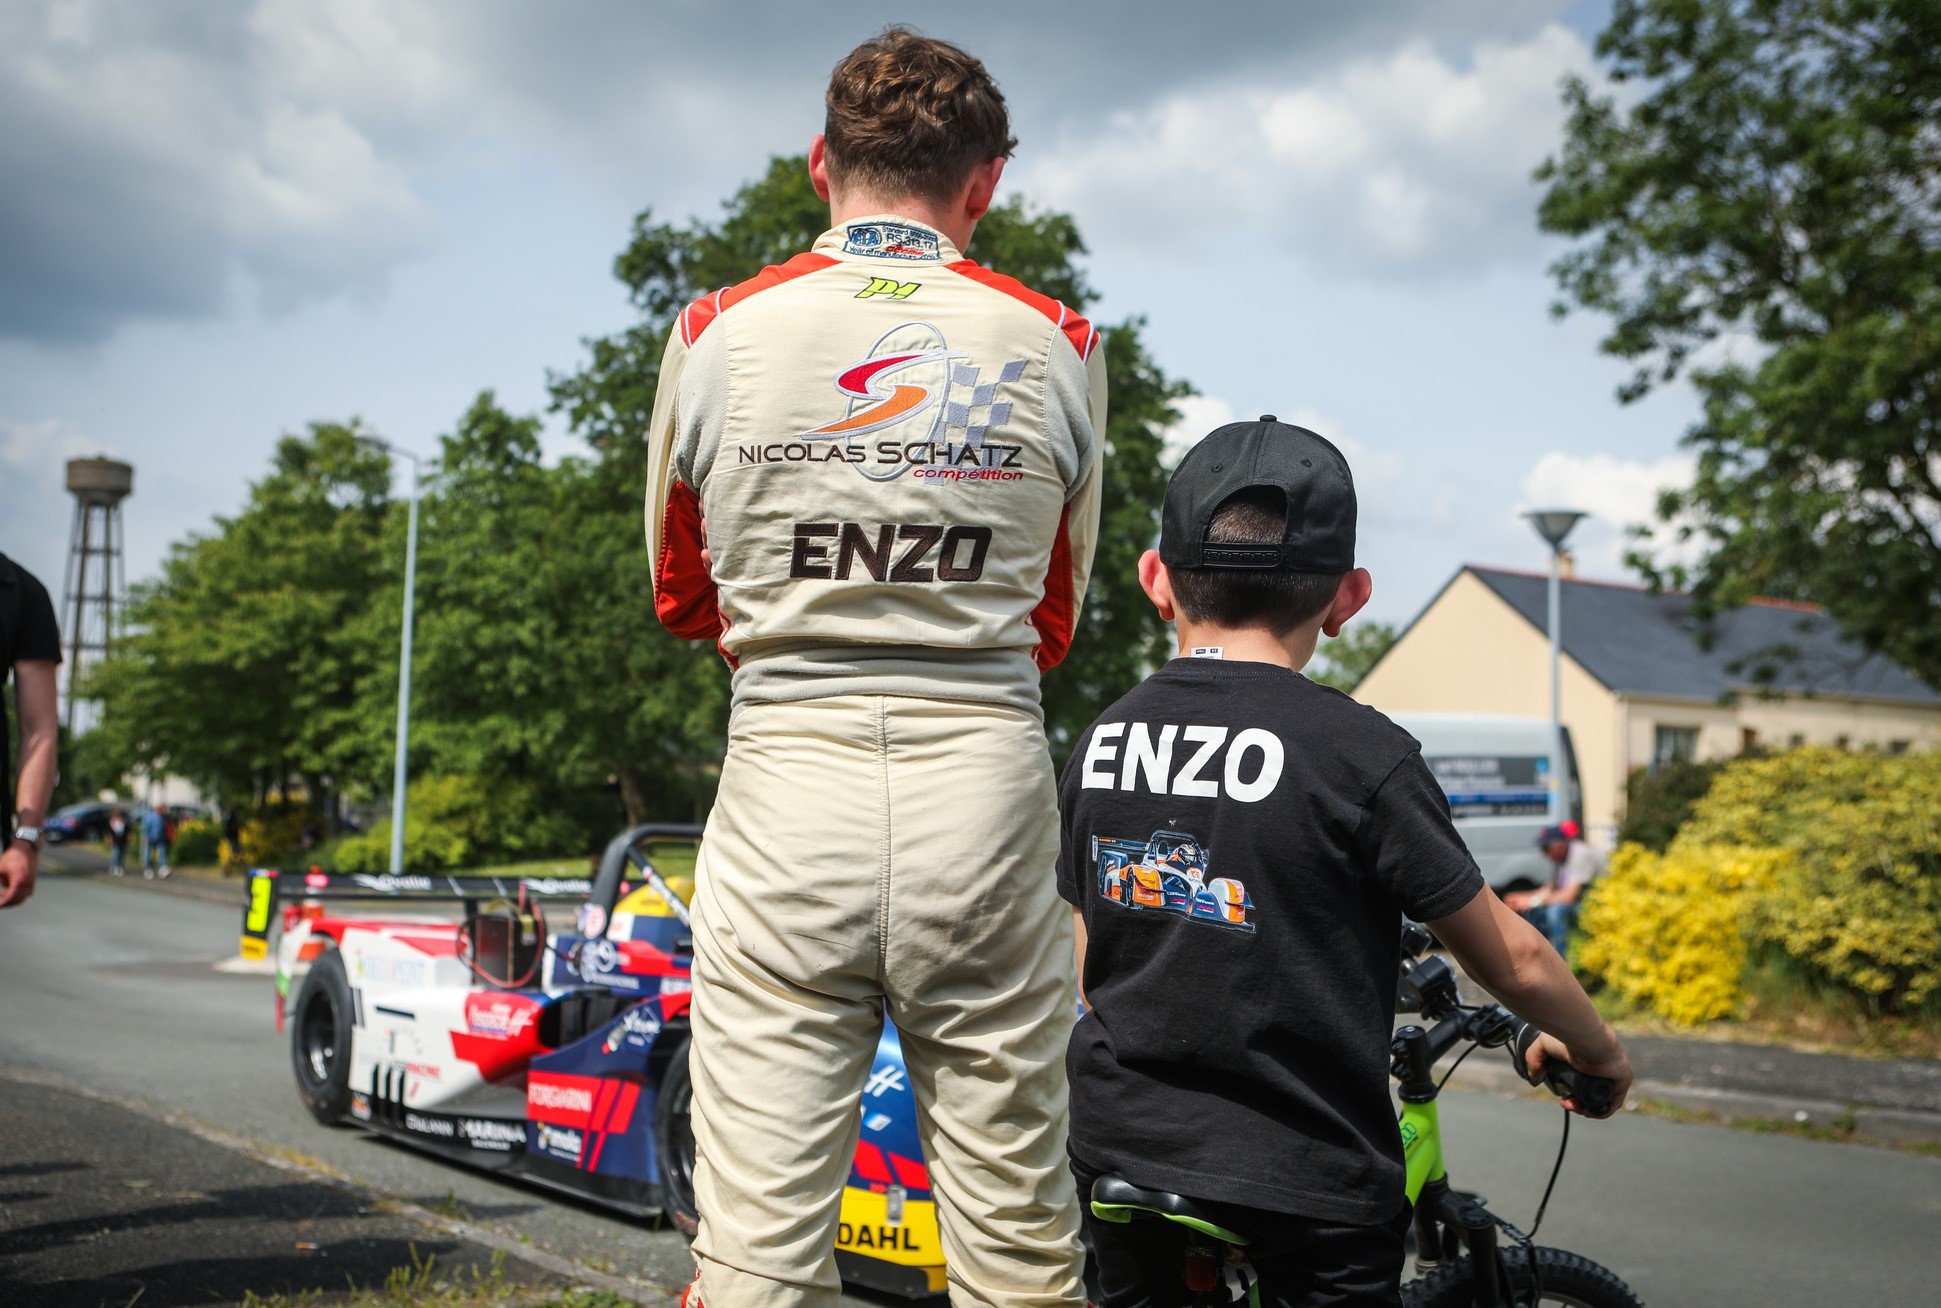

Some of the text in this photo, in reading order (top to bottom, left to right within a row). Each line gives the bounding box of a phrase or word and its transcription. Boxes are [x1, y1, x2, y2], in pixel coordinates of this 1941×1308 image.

[854, 276, 922, 300] P1
[738, 442, 1023, 468] NICOLAS SCHATZ
[913, 467, 1024, 481] compétition
[790, 522, 993, 582] ENZO
[1081, 722, 1285, 803] ENZO
